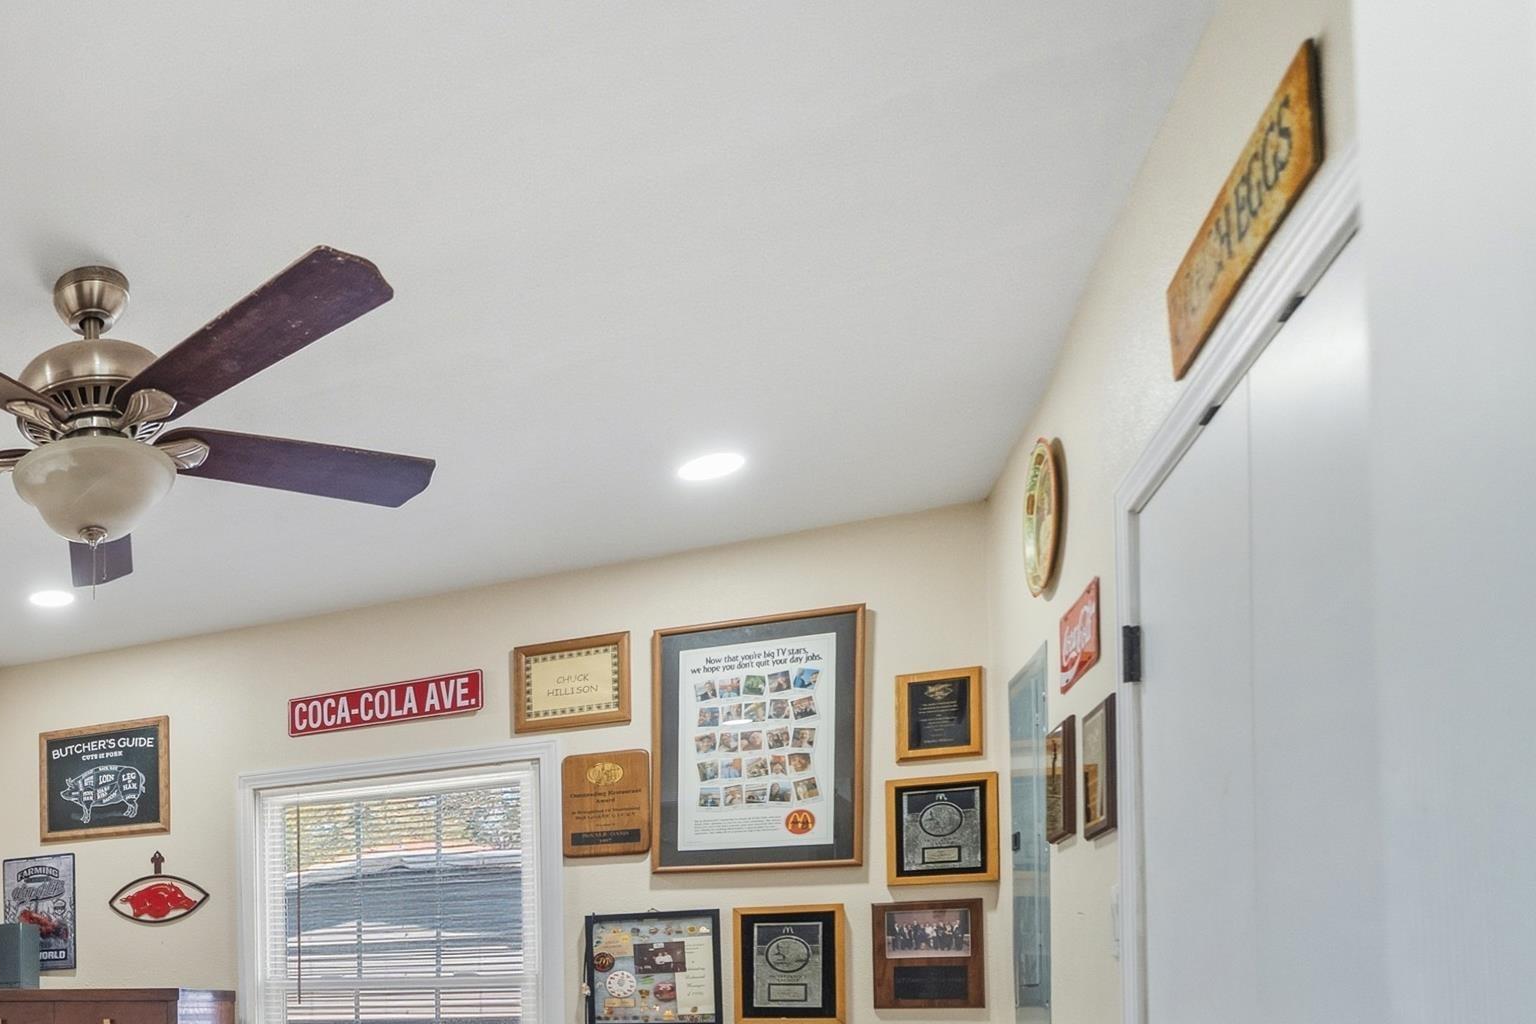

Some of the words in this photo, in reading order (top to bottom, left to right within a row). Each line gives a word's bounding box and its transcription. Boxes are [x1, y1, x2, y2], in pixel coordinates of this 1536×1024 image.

[1233, 94, 1293, 242] EGGS
[705, 657, 721, 666] Now
[724, 655, 738, 664] that
[741, 653, 762, 663] you're
[763, 649, 775, 659] big
[776, 648, 787, 657] TV
[702, 664, 720, 675] hope
[722, 662, 735, 672] you
[737, 660, 754, 670] don't
[755, 658, 770, 669] quit
[771, 656, 788, 666] your
[789, 655, 804, 665] day
[556, 673, 589, 685] CHUCK
[547, 684, 598, 697] HILLISON
[293, 686, 418, 731] COCA-COLA
[424, 677, 476, 712] AVE.
[52, 738, 116, 760] BUTCHER'S
[117, 737, 155, 749] GUIDE
[81, 753, 98, 761] CUTS
[105, 750, 123, 758] PORK
[98, 773, 115, 785] LOIN
[121, 772, 136, 781] LEG
[123, 783, 137, 791] HAM
[17, 866, 59, 881] FARMING
